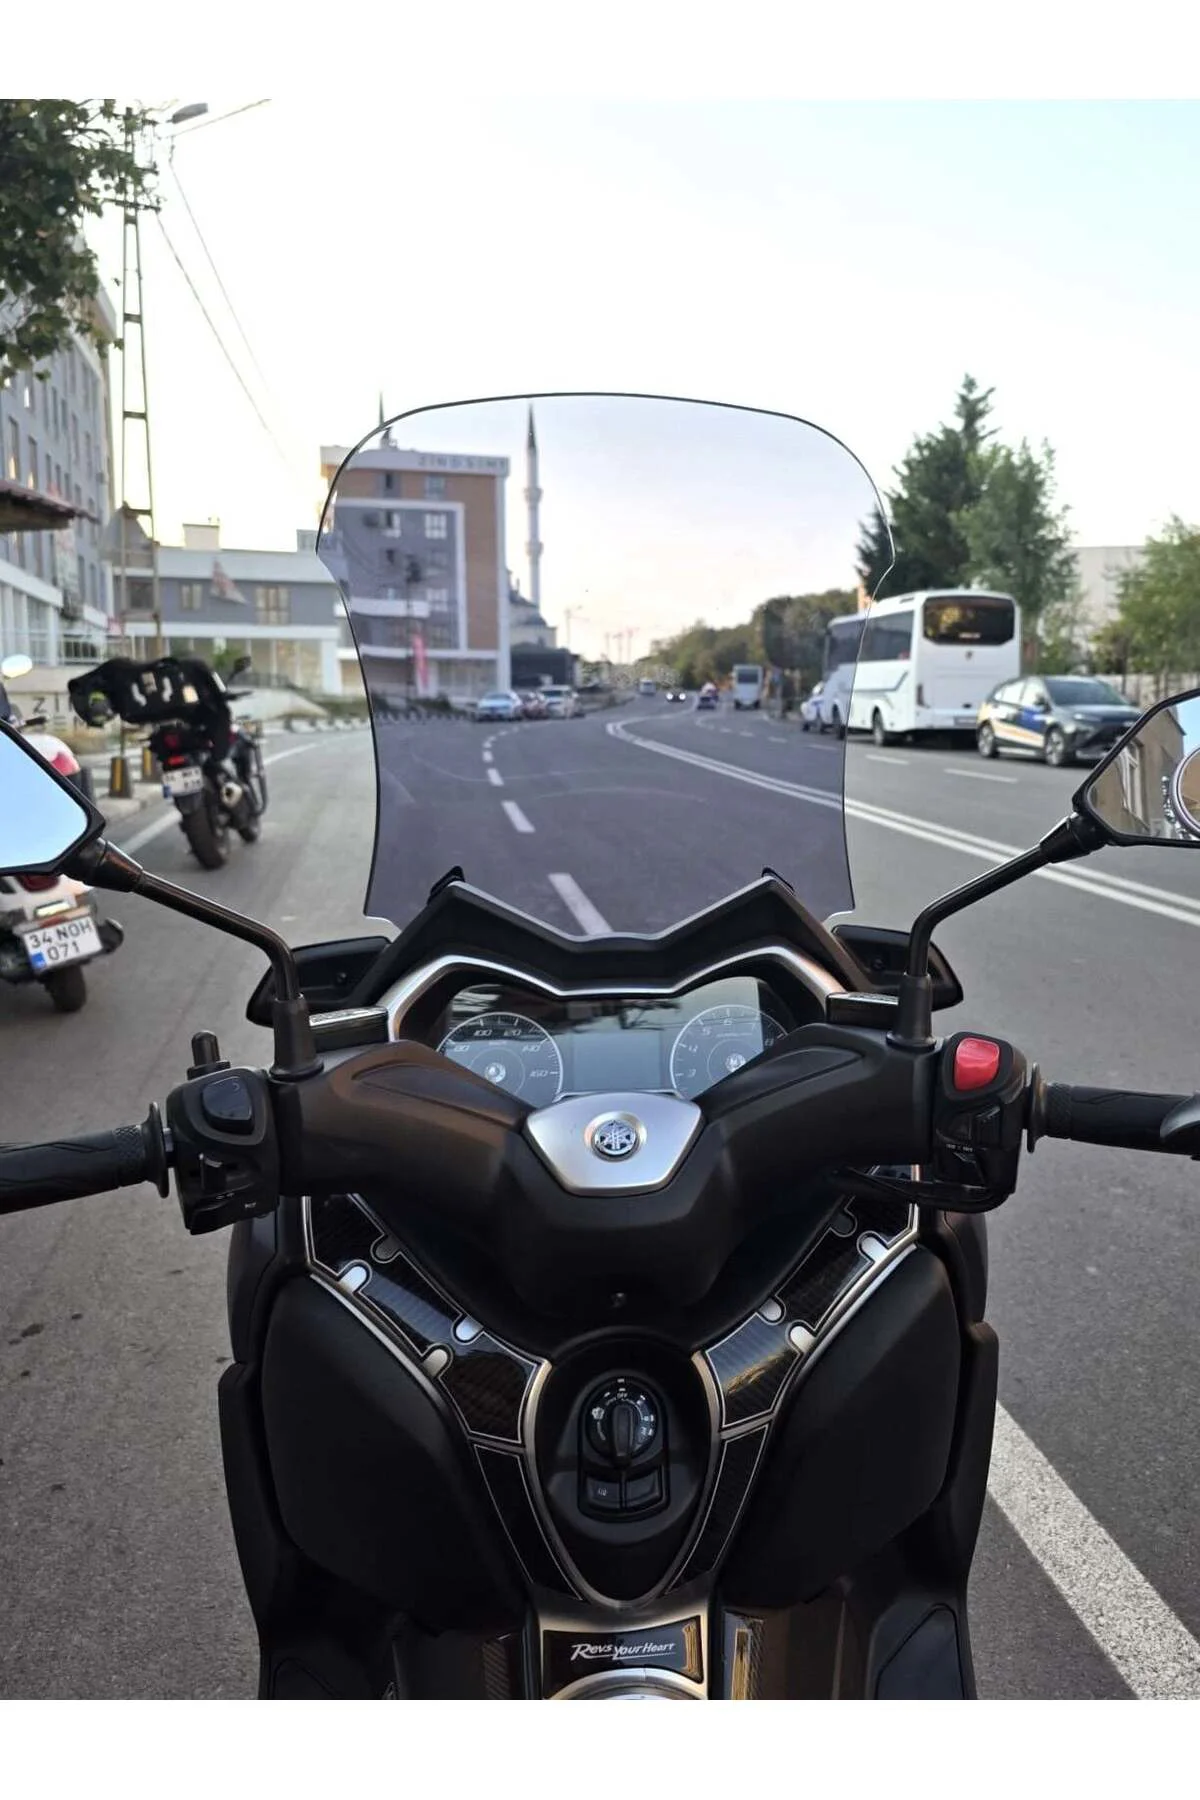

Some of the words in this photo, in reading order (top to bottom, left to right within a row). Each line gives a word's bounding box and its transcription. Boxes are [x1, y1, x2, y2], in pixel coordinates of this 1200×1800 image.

[29, 931, 53, 949] 34
[47, 941, 80, 961] 071
[473, 1029, 493, 1037] 100
